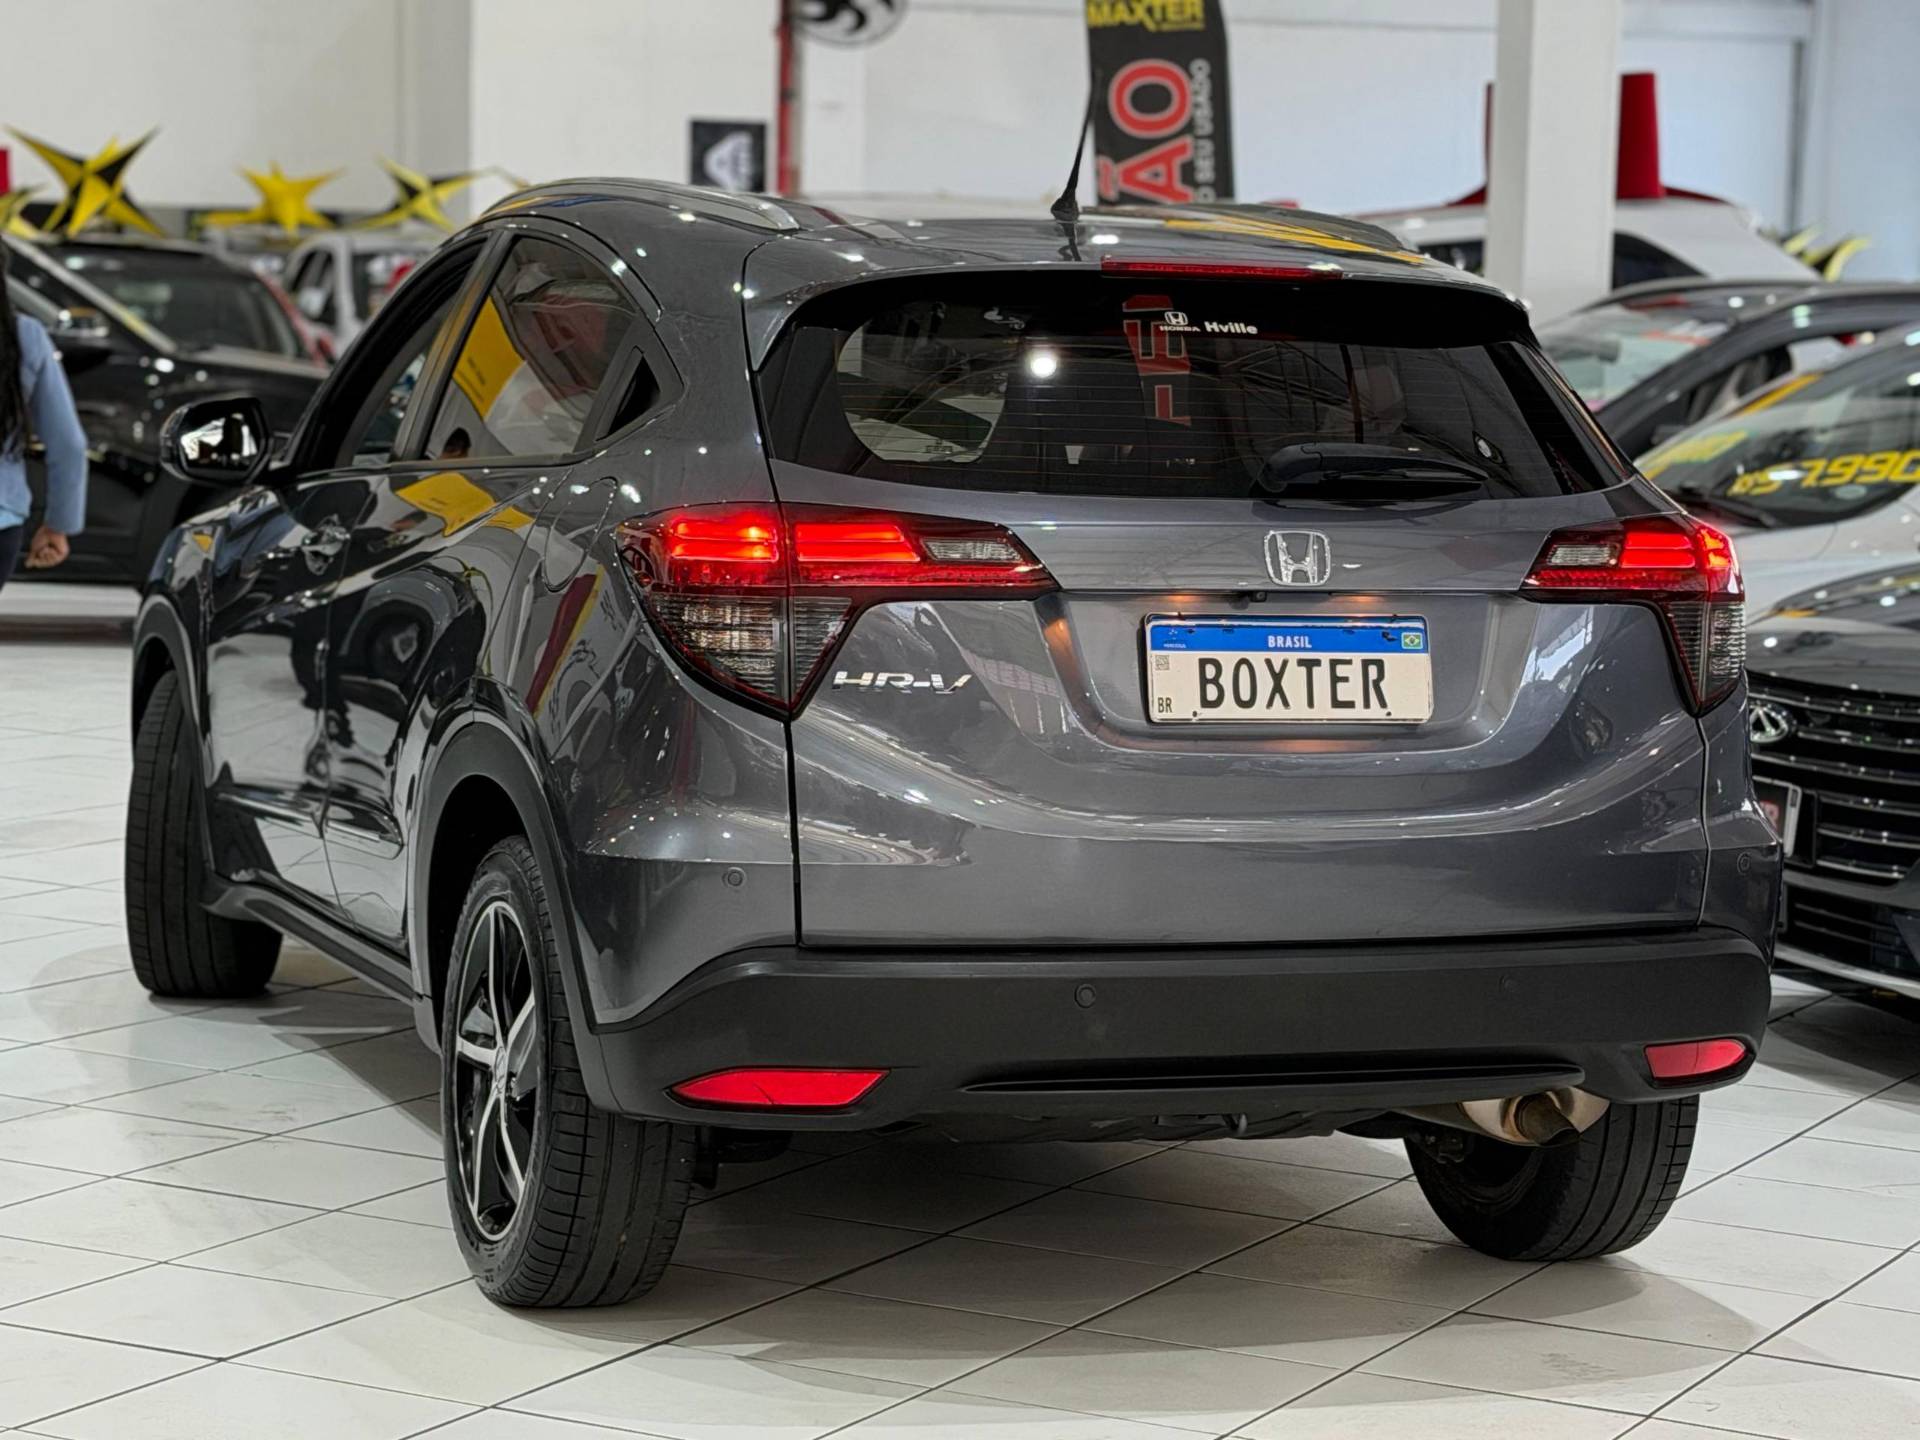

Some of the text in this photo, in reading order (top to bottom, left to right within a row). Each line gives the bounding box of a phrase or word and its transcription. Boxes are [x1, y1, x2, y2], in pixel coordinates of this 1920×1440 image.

[1189, 58, 1213, 136] USADO
[1194, 138, 1215, 183] SEU
[1204, 321, 1258, 334] Hville
[1268, 635, 1312, 648] BRASIL
[832, 671, 972, 693] HR-V
[1198, 657, 1388, 710] BOXTER
[1157, 697, 1173, 713] BR
